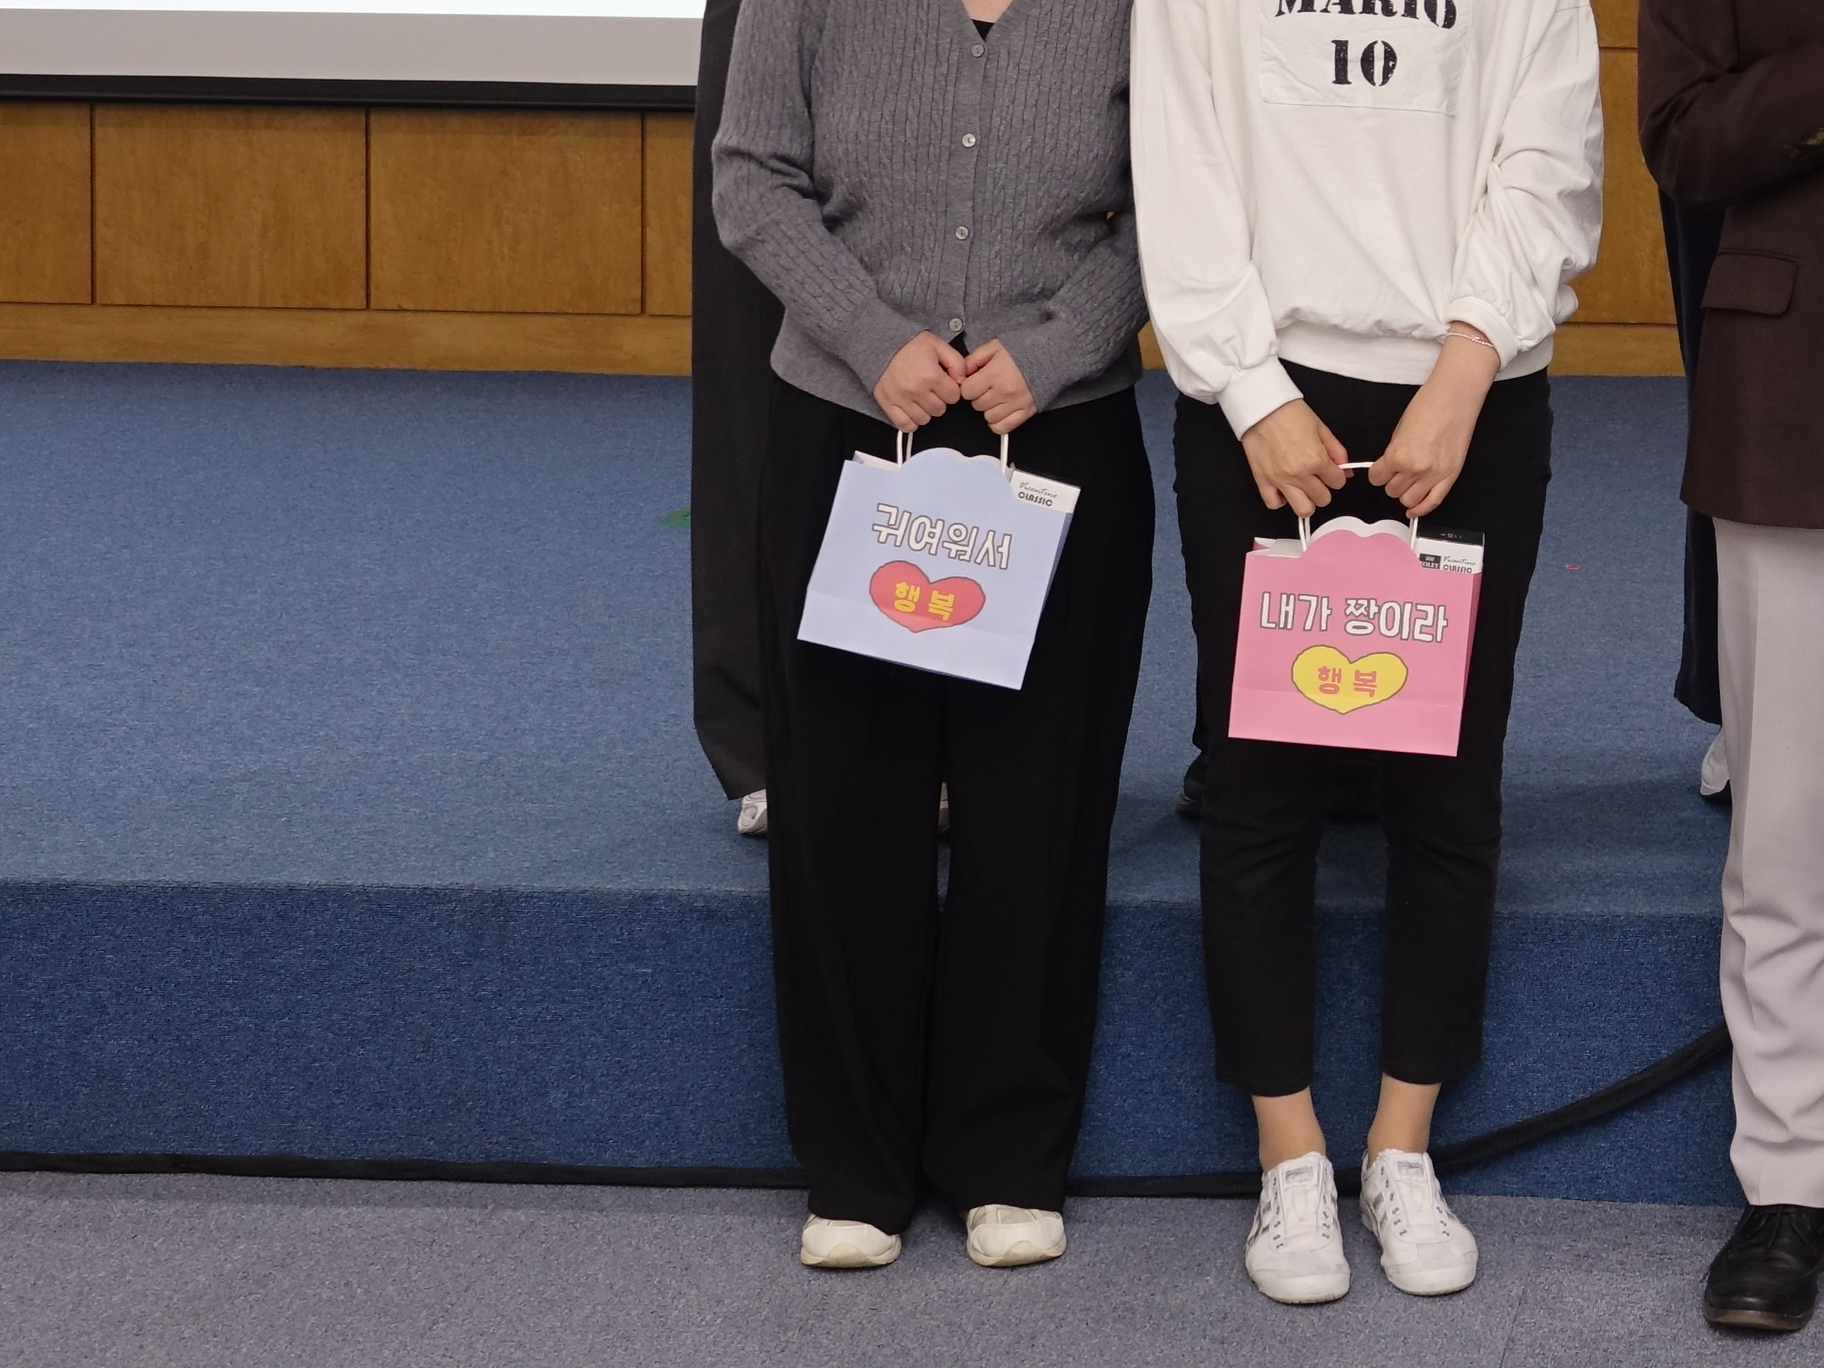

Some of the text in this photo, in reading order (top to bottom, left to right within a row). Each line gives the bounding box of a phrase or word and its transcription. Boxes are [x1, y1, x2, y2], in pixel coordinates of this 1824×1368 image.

[1330, 39, 1398, 87] 10
[1017, 491, 1054, 507] CLASSIC
[872, 502, 1013, 571] 귀여워서
[1442, 564, 1473, 574] CLASSIC
[893, 581, 956, 621] 행복
[1259, 591, 1449, 643] 내가 짱이라
[1317, 665, 1378, 698] 행복
